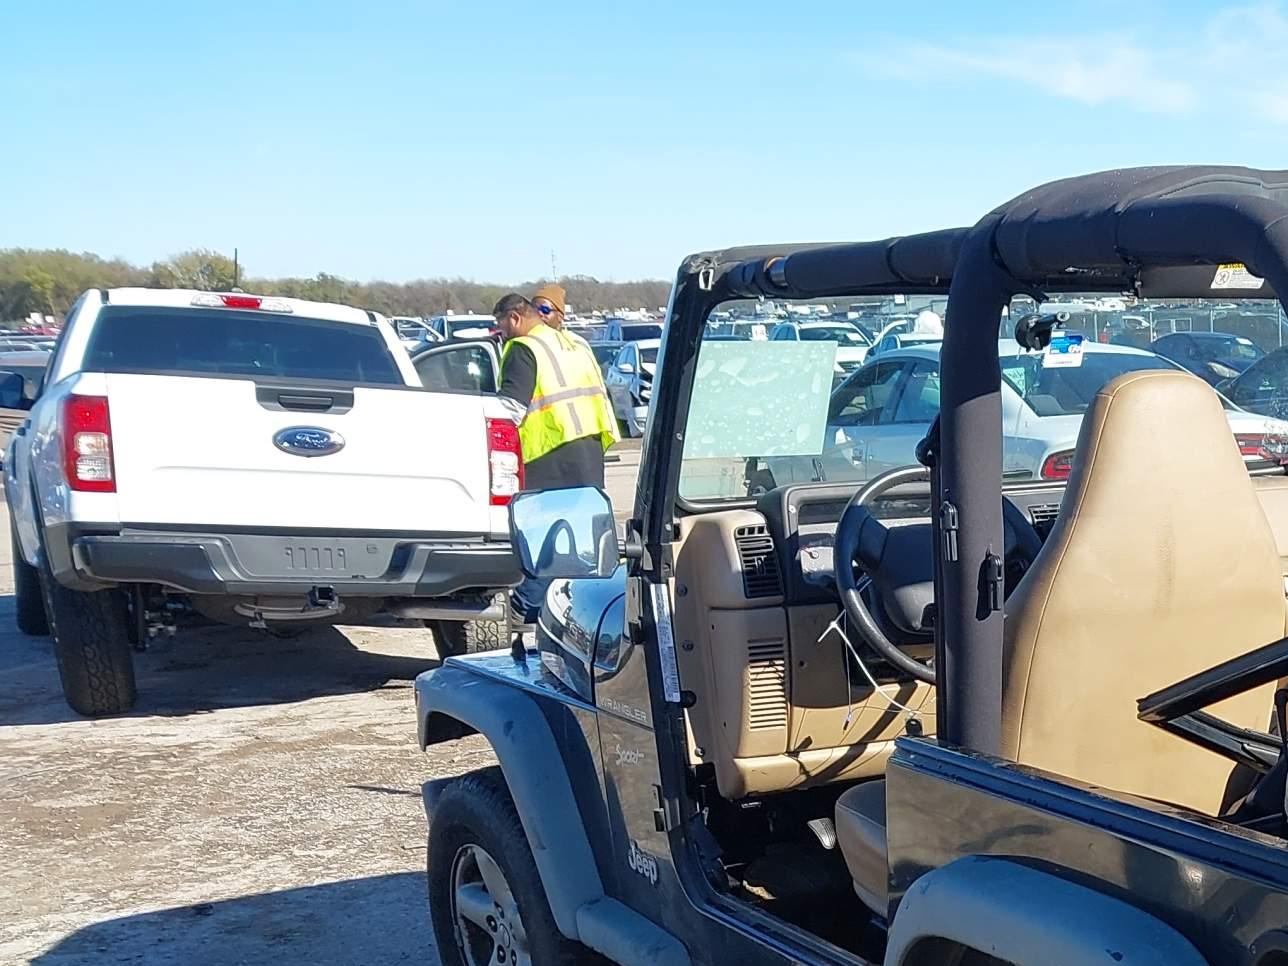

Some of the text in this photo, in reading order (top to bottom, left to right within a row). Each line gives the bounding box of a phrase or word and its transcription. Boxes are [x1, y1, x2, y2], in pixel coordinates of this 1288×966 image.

[599, 696, 647, 722] WRANGLER
[614, 743, 645, 766] Sport
[627, 840, 658, 886] Jeep
